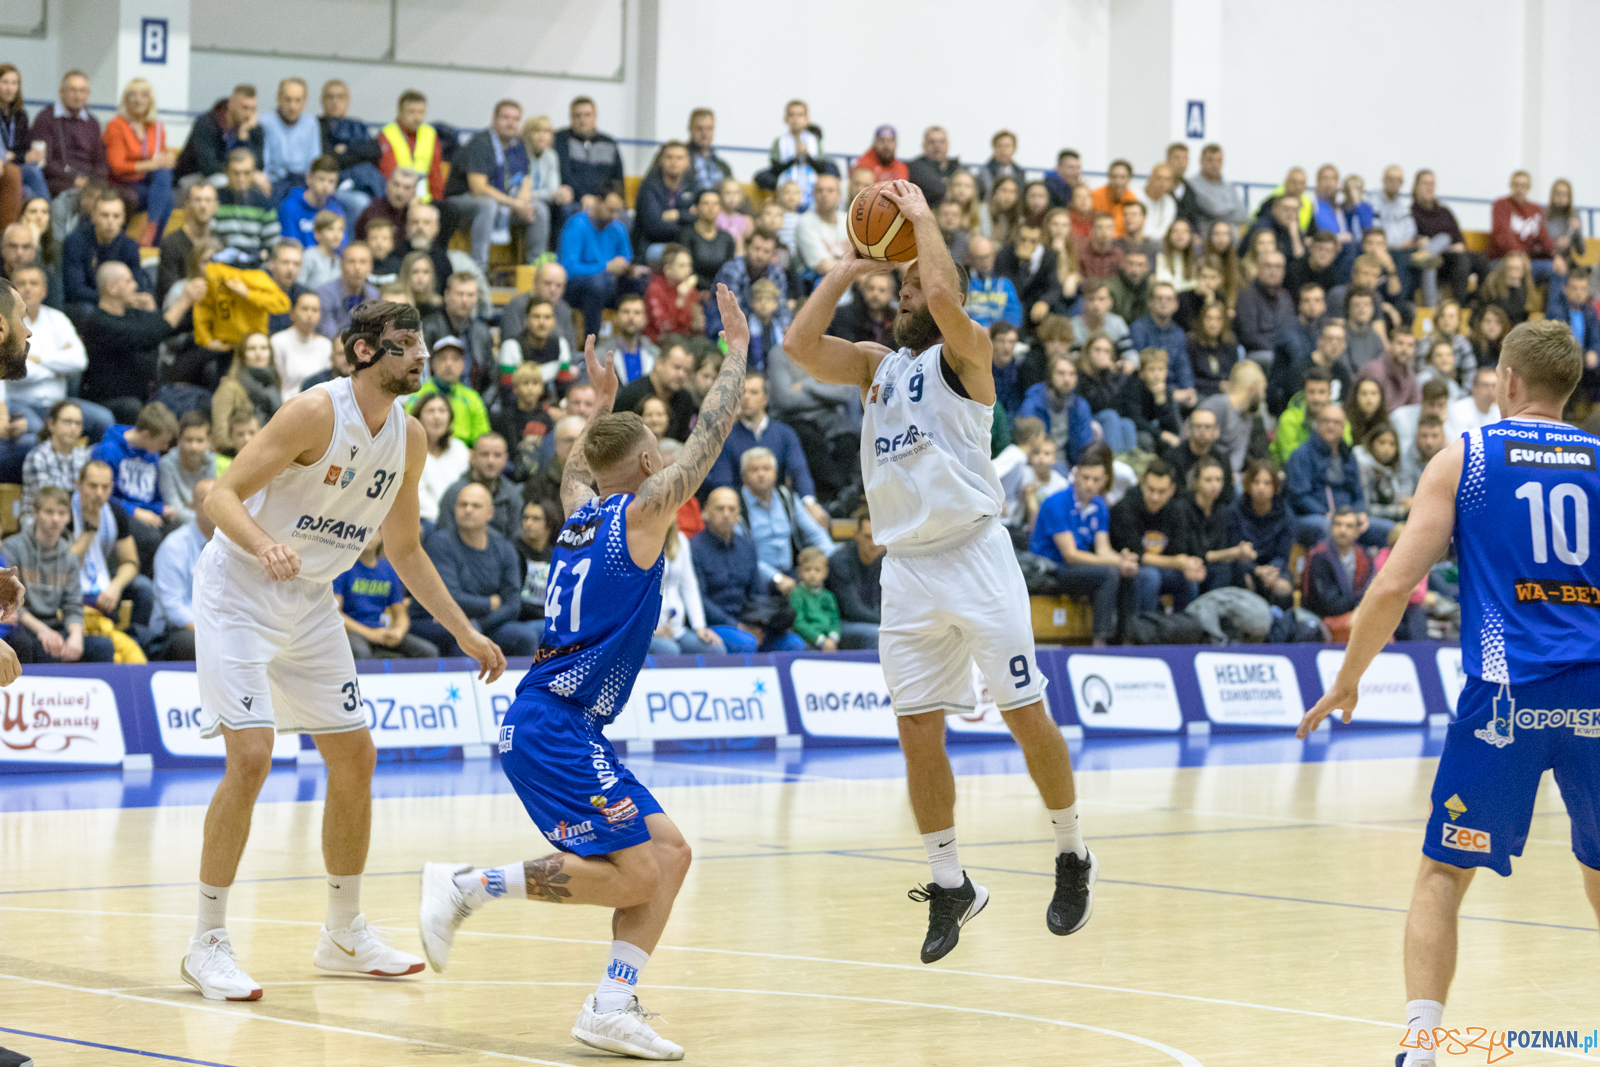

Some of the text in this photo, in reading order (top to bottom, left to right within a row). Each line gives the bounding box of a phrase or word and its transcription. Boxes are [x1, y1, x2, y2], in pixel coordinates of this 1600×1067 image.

[145, 23, 163, 58] B
[1189, 104, 1202, 132] A
[916, 363, 923, 373] C
[908, 373, 924, 403] 9
[1487, 428, 1539, 440] POGOŃ
[366, 469, 396, 500] 31
[1515, 481, 1590, 566] 10
[544, 557, 592, 633] 41
[1009, 654, 1031, 689] 9
[1215, 663, 1279, 685] HELMEX
[3, 691, 28, 732] U
[362, 698, 458, 730] OZnan
